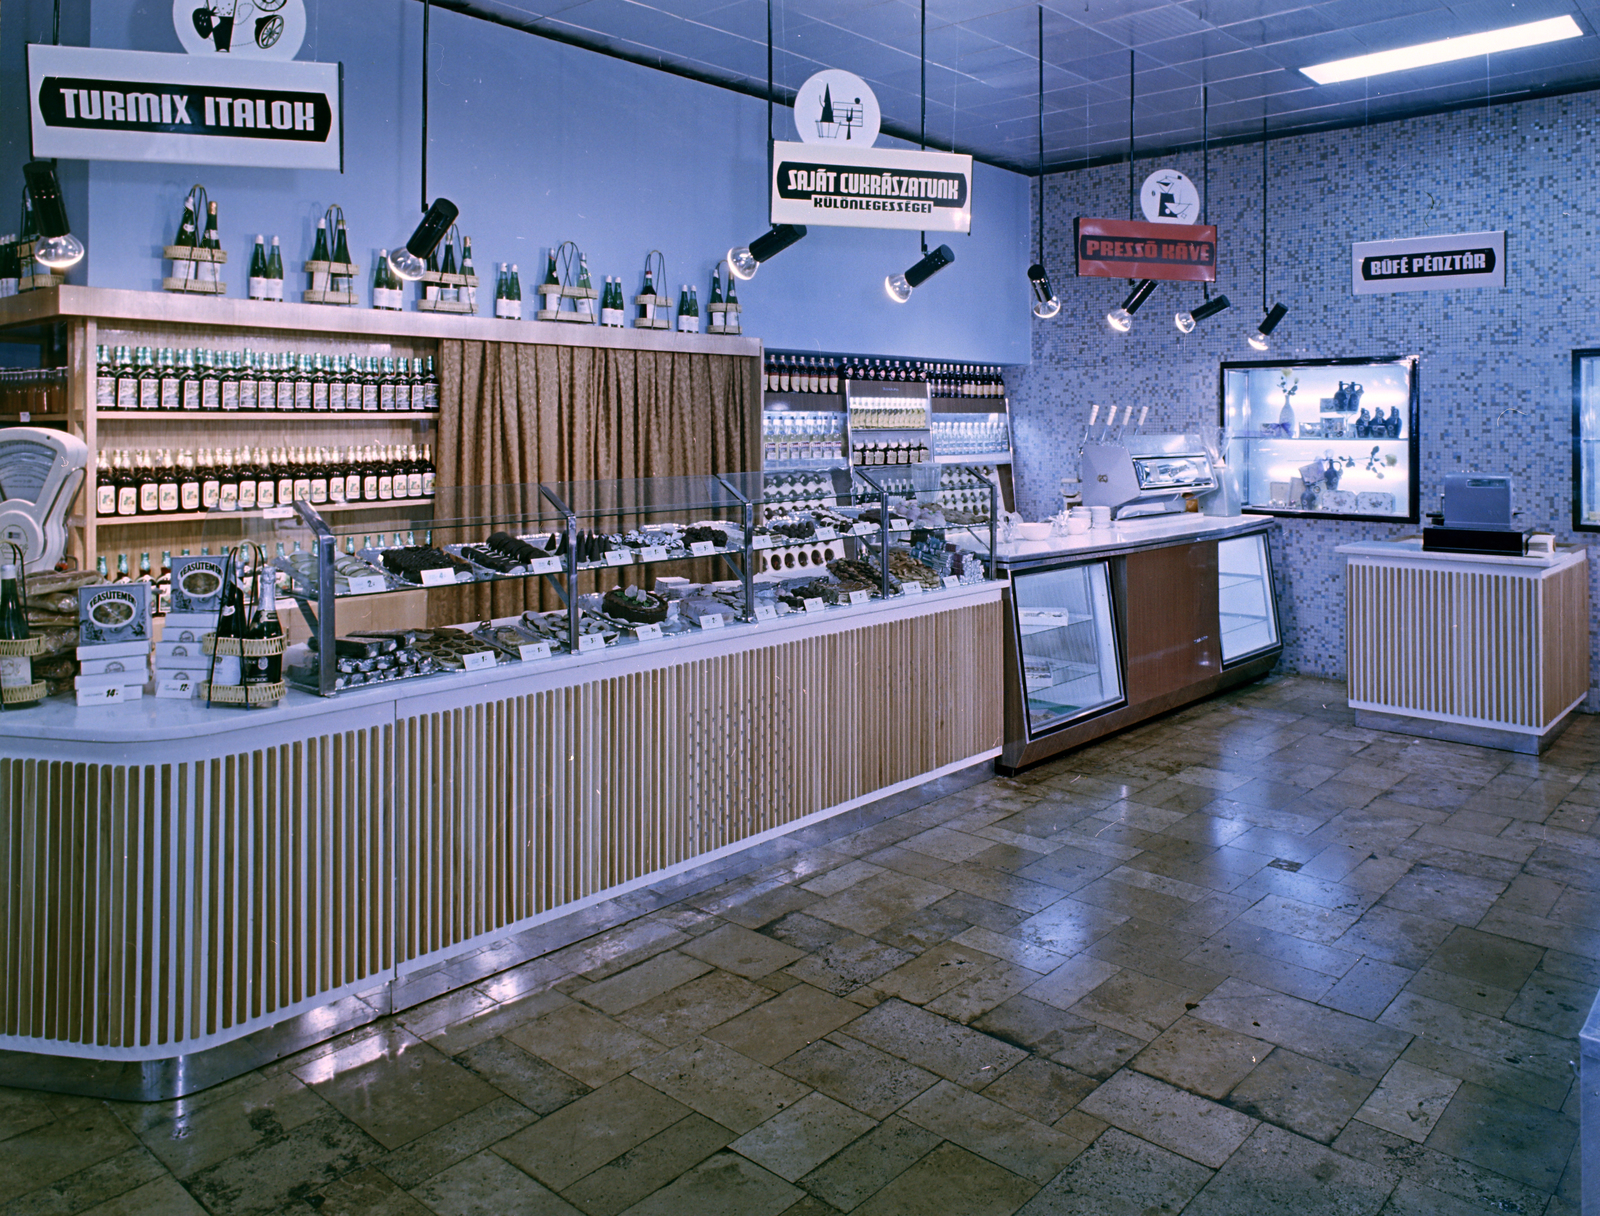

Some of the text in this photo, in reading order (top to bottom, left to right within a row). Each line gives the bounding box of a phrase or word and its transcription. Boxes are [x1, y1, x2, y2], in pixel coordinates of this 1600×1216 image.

[59, 88, 315, 132] TURMIX ITALOK
[787, 168, 959, 200] SAJÁT CUKRÁSZATUNK
[813, 196, 932, 214] KÜLÖNLEGESSÉGEI
[1162, 242, 1210, 262] KÁVÉ
[1412, 252, 1486, 273] PÉNZTÁR
